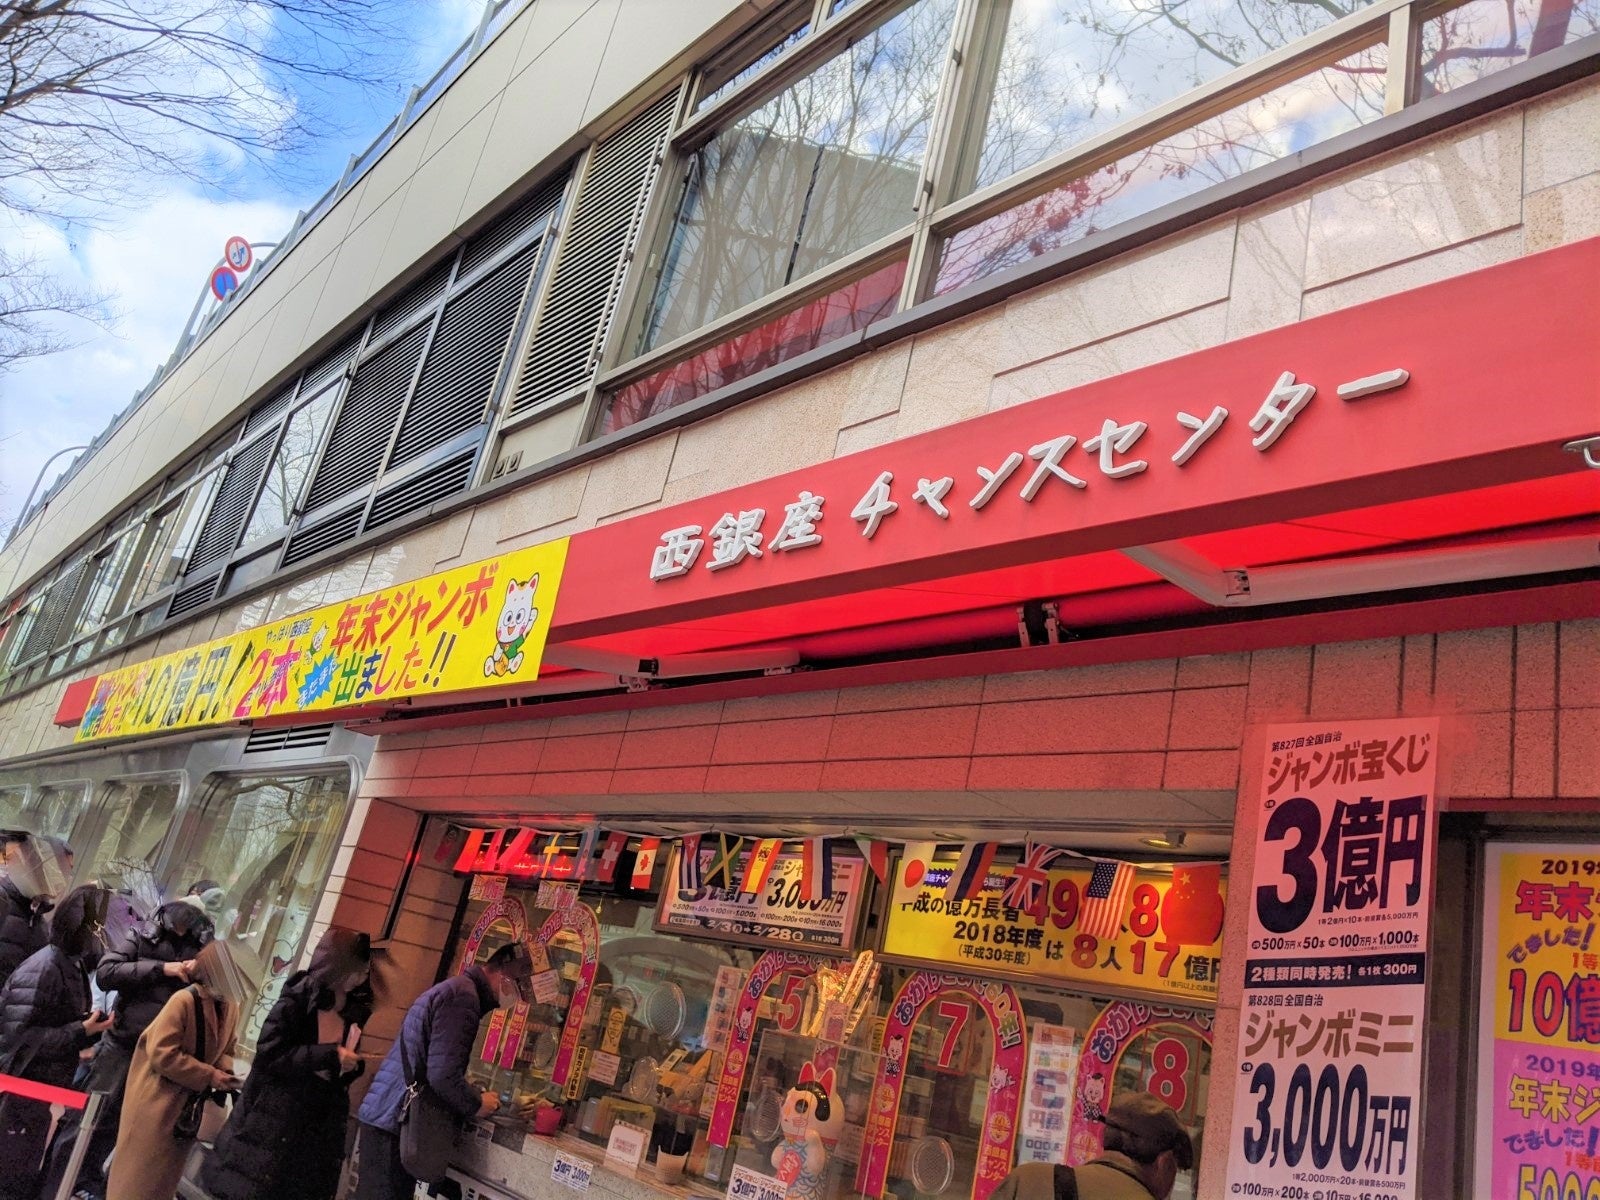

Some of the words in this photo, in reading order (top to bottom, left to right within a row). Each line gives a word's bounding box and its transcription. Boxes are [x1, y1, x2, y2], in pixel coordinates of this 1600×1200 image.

[330, 561, 500, 656] 年末ジャンボ
[333, 631, 457, 705] 出ました!!
[1267, 733, 1431, 795] ジャンボ宝くじ
[1256, 794, 1427, 934] 3億円
[1541, 860, 1600, 875] 2019
[1515, 880, 1600, 923] 年末
[953, 920, 1044, 950] 2018年度
[956, 946, 1032, 966] (平成30年度)
[1506, 922, 1596, 963] でました!
[1250, 965, 1352, 983] 2種類同時発売!
[777, 975, 807, 1031] 5
[937, 1001, 970, 1068] 7
[1244, 1008, 1415, 1059] ジャンボミニ
[1146, 1037, 1190, 1113] 8
[1243, 1062, 1412, 1176] 3,000万円
[1503, 1125, 1600, 1158] でました!
